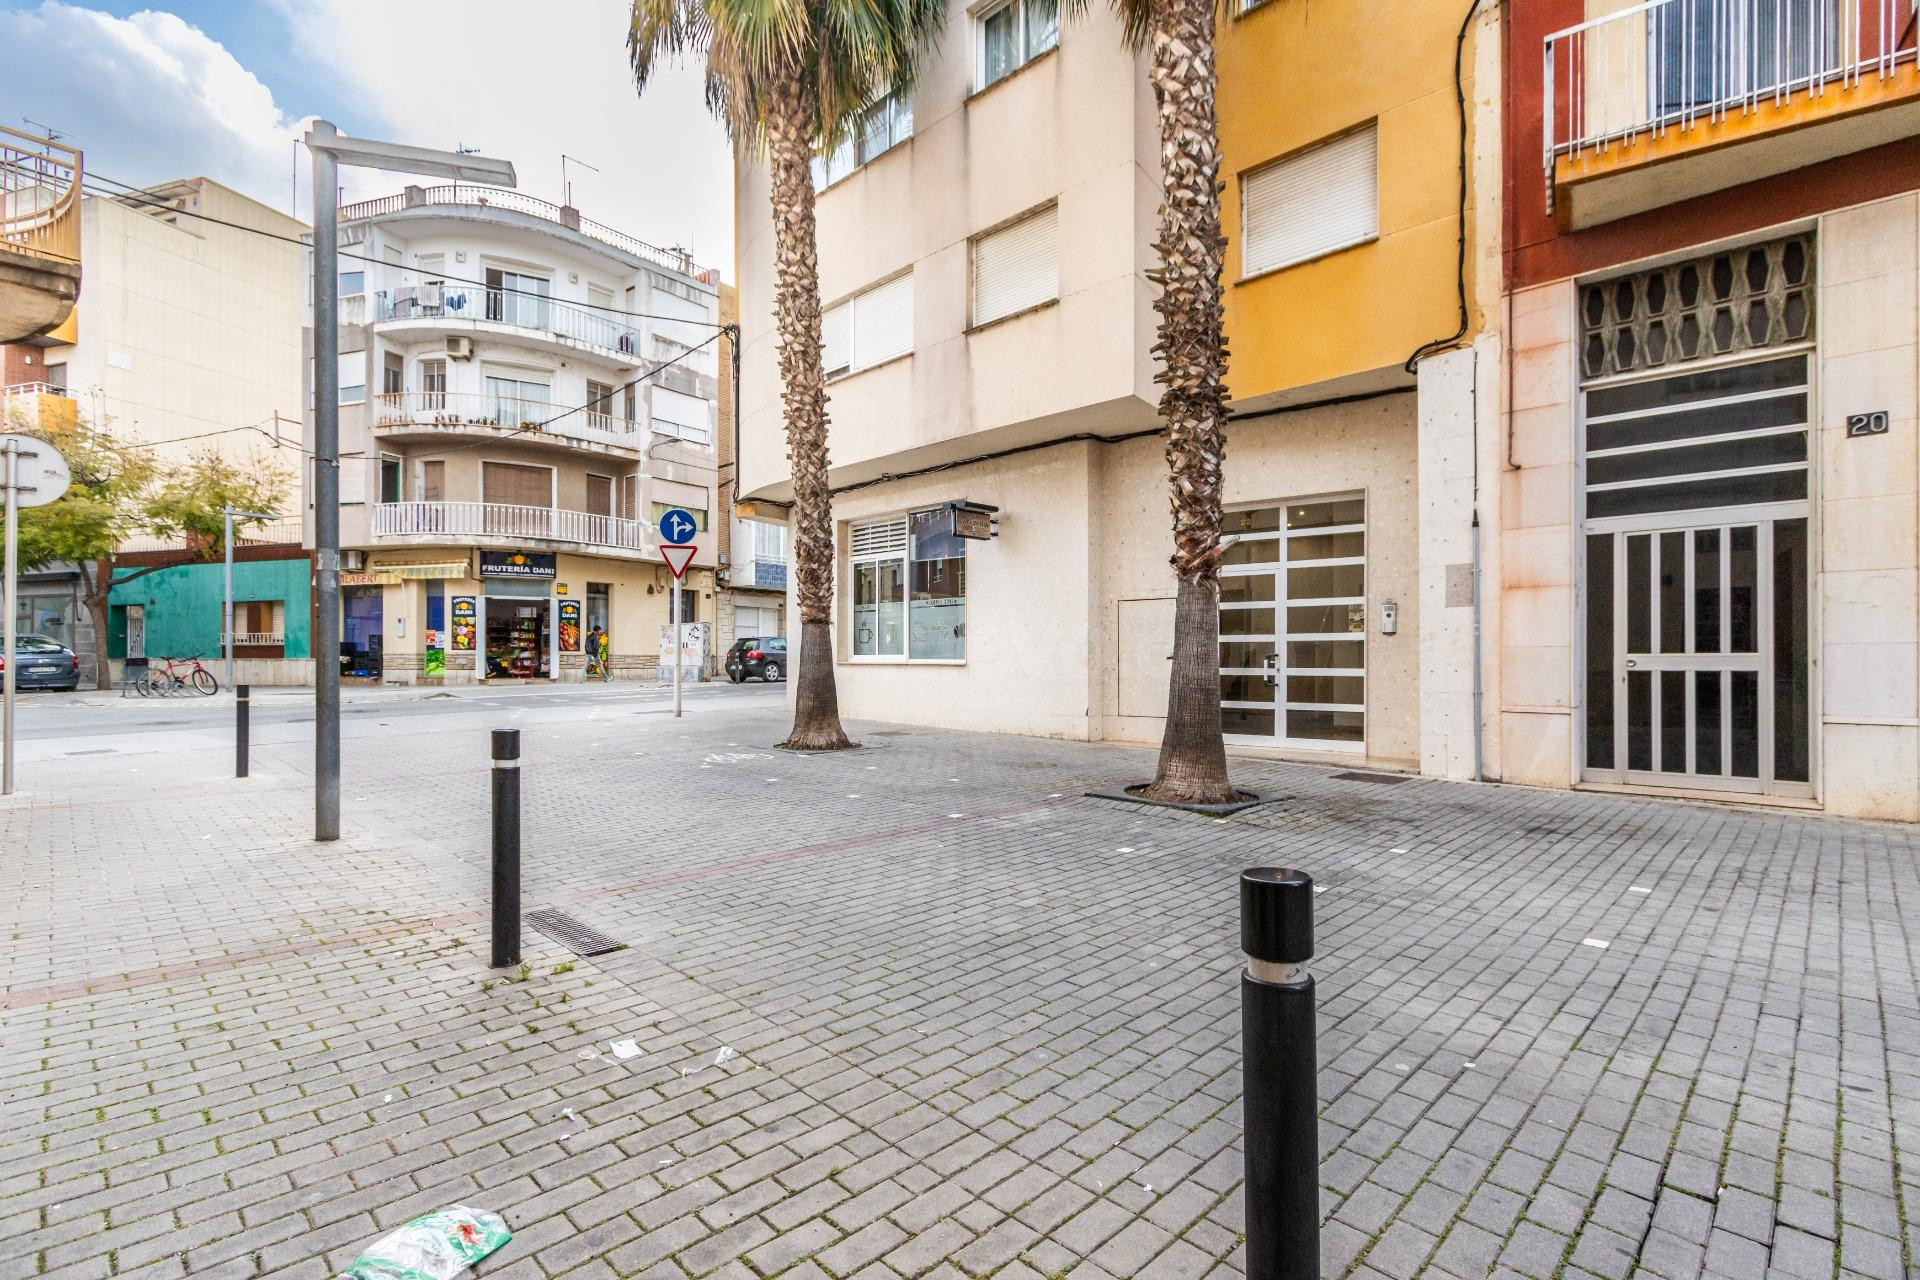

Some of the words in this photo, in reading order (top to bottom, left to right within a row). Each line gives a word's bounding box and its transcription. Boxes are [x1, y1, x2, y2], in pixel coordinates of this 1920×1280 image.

[1851, 412, 1887, 435] 20
[482, 564, 531, 573] FRUTERÍA
[532, 567, 555, 575] DANI
